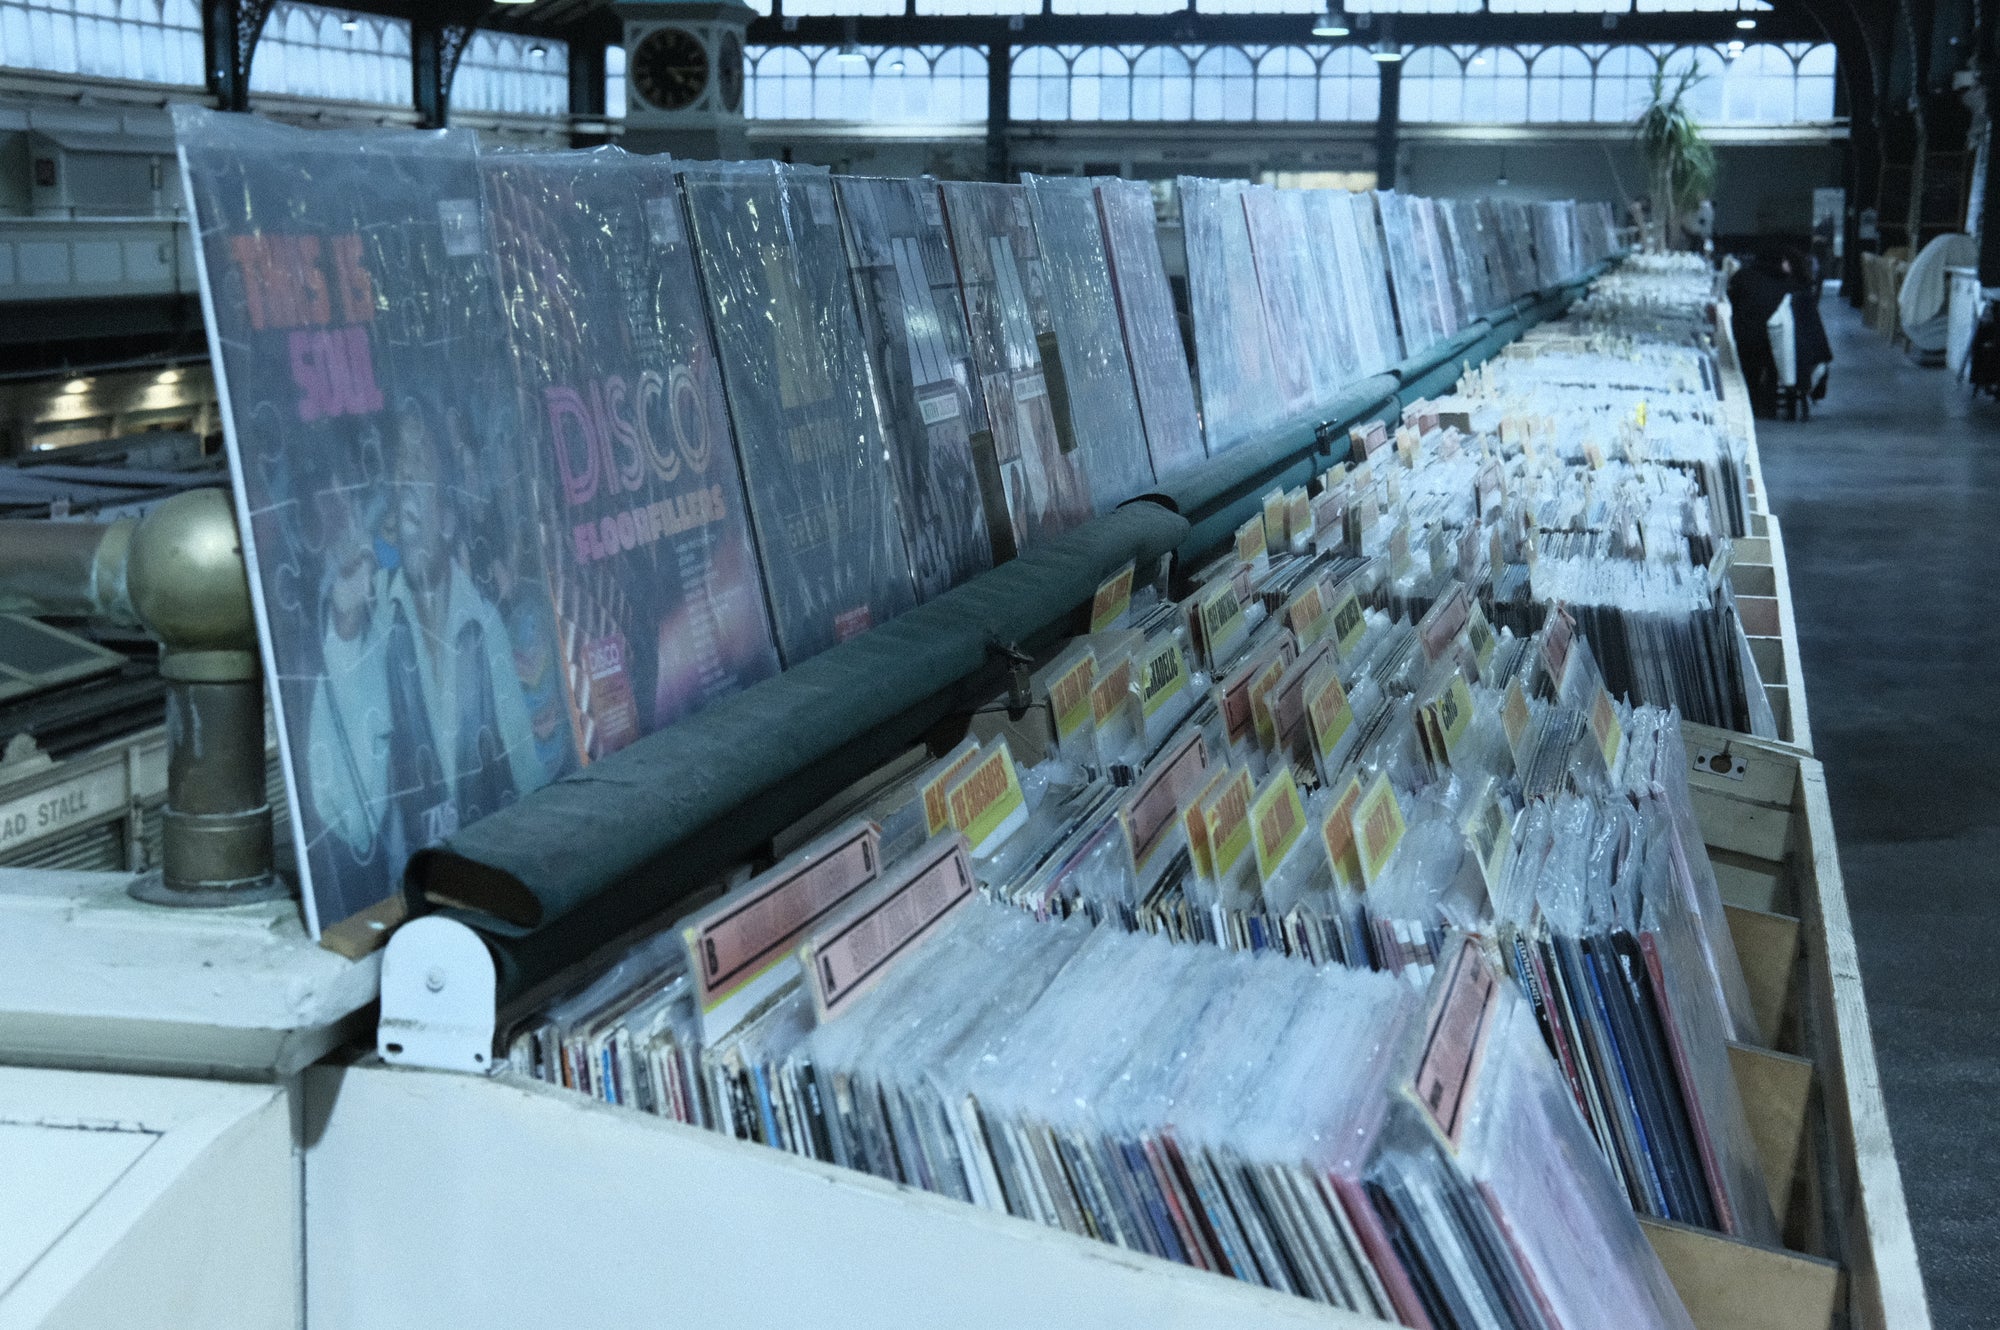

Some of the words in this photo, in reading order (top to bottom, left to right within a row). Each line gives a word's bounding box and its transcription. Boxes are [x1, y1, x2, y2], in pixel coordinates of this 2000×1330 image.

[546, 364, 711, 504] DISCO
[573, 483, 727, 565] FLOORFILLERS
[38, 789, 88, 827] STALL
